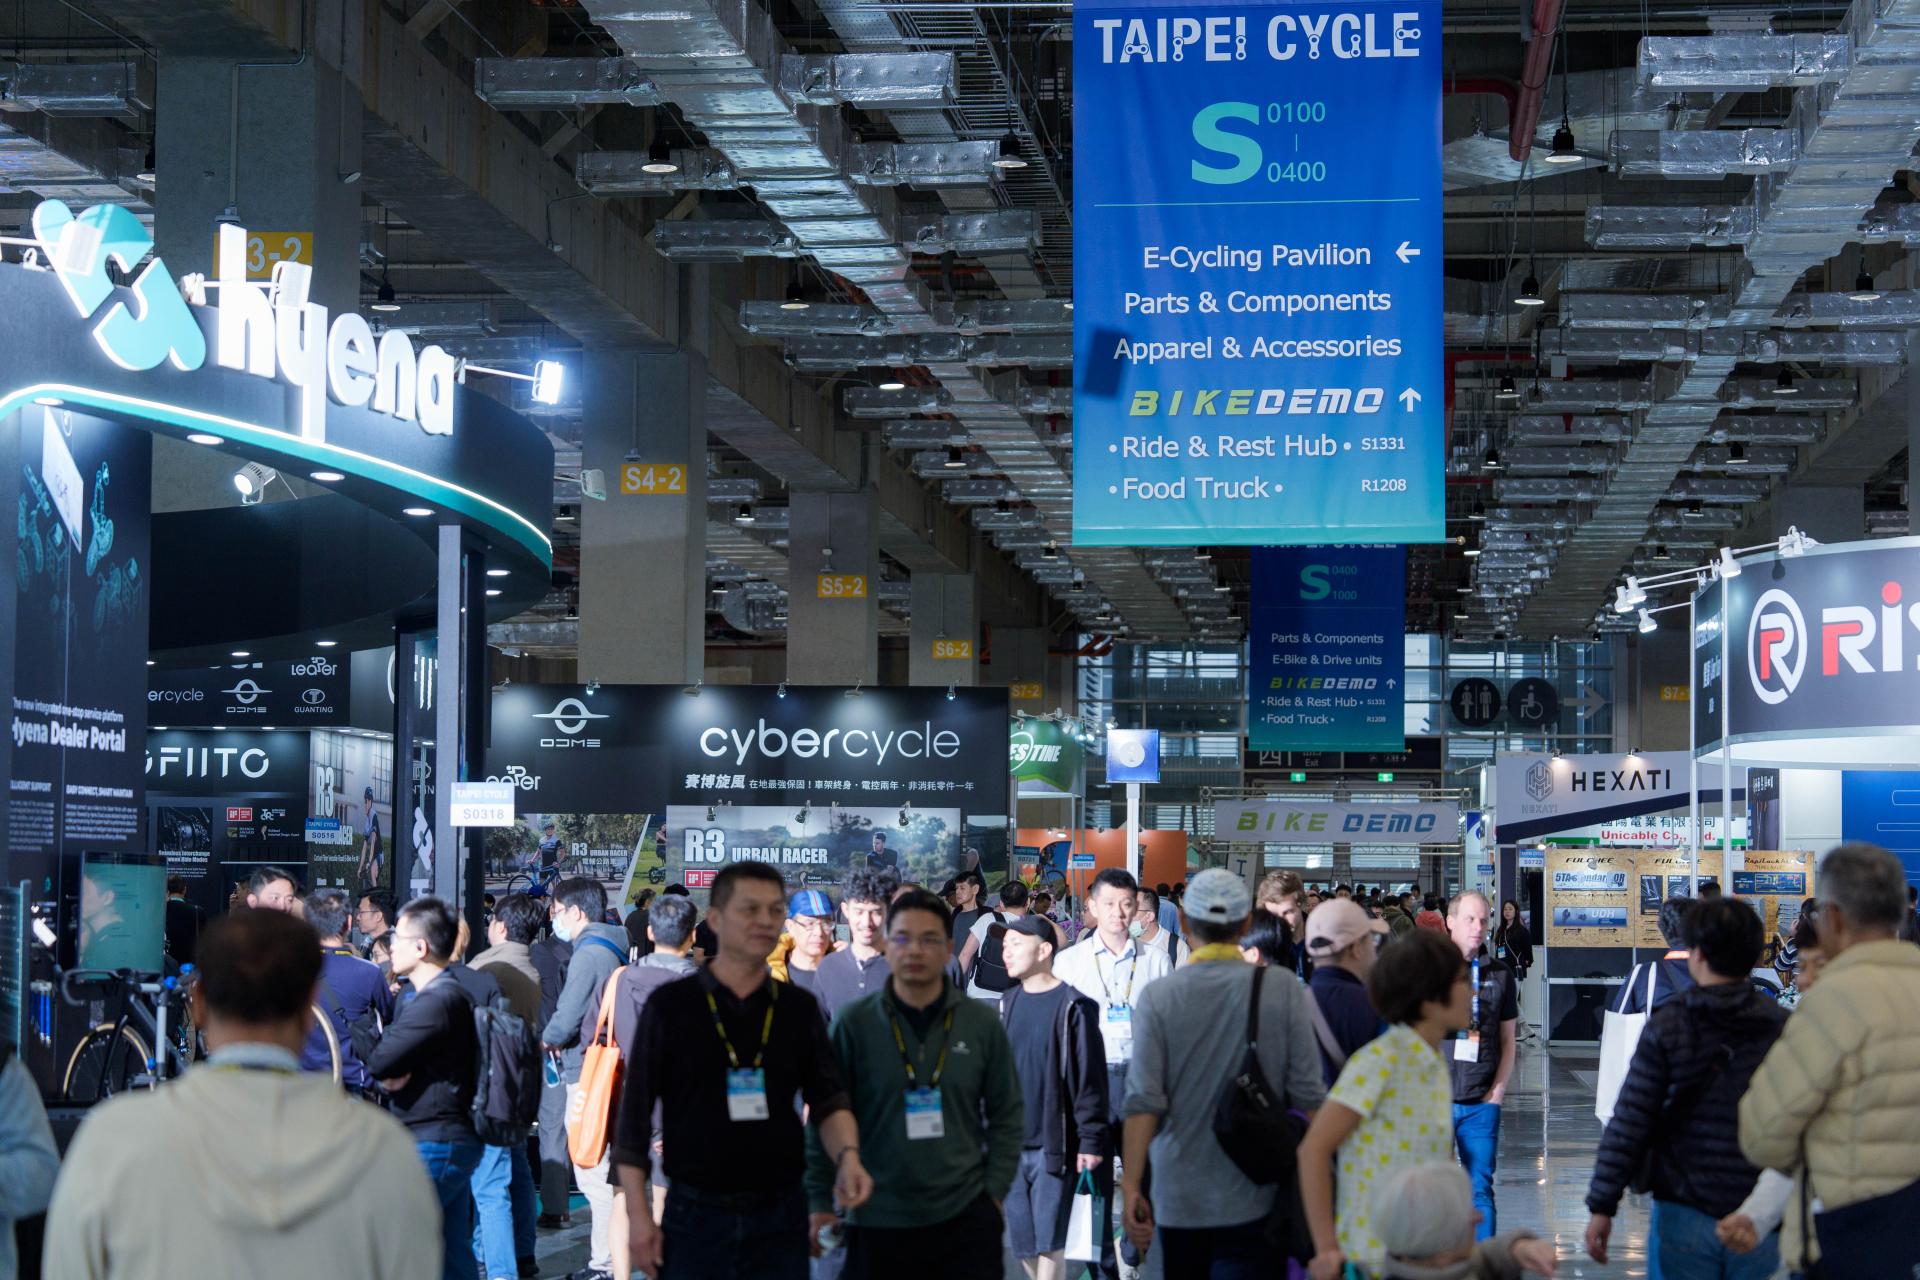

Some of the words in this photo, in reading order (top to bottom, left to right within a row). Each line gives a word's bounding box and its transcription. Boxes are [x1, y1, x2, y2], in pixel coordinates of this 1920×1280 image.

[1093, 16, 1247, 64] TAIPEI
[1267, 12, 1421, 61] CYCLE
[1267, 101, 1326, 124] 0100
[1191, 101, 1263, 185] S
[1267, 161, 1326, 183] 0400
[246, 236, 302, 272] 3-2
[1143, 244, 1262, 273] E-Cycling
[1272, 243, 1371, 267] Pavilion
[1124, 292, 1190, 314] Parts
[1198, 291, 1220, 313] &
[1227, 289, 1392, 317] Components
[218, 222, 455, 443] hyena
[1113, 336, 1213, 365] Apparel
[1222, 336, 1244, 358] &
[1250, 335, 1402, 358] Accessories
[1122, 435, 1180, 459] Ride
[1188, 436, 1210, 457] &
[1217, 435, 1276, 458] Rest
[1284, 434, 1338, 457] Hub
[1361, 437, 1406, 451] S1331
[624, 466, 682, 491] S4-2
[1122, 476, 1186, 499] Food
[1194, 475, 1270, 498] Truck
[1361, 479, 1407, 492] R1208
[1332, 565, 1358, 576] 0400
[821, 577, 863, 596] S5-2
[1299, 564, 1331, 601] S
[1332, 590, 1358, 600] 1000
[935, 642, 969, 657] S6-2
[1271, 633, 1299, 645] Parts
[1302, 633, 1312, 644] &
[1314, 632, 1384, 646] Components
[1272, 654, 1308, 665] E-Bike
[1310, 654, 1320, 665] &
[1323, 654, 1352, 665] Drive
[1355, 654, 1383, 665] units
[147, 688, 204, 704] ercycle
[1011, 684, 1042, 697] S7-2
[1266, 696, 1291, 707] Ride
[1294, 696, 1304, 707] &
[1306, 696, 1332, 707] Rest
[1334, 696, 1358, 707] Hub
[1266, 714, 1294, 725] Food
[1297, 713, 1329, 725] Truck
[50, 720, 90, 749] Dealer
[90, 726, 126, 752] Portal
[699, 718, 961, 766] cybercycle
[1305, 758, 1319, 767] Exit
[315, 766, 334, 818] R3
[684, 774, 746, 789] 賽博旋風
[463, 808, 505, 820] S0318
[1236, 812, 1329, 832] BIKE
[1341, 813, 1437, 833] DEMO
[311, 831, 335, 839] S0516
[683, 828, 725, 863] R3
[1601, 830, 1658, 841] Unicable
[571, 842, 588, 857] R3
[590, 849, 608, 857] URBAN
[610, 849, 628, 857] RACER
[731, 847, 781, 864] URBAN
[782, 848, 828, 864] RACER
